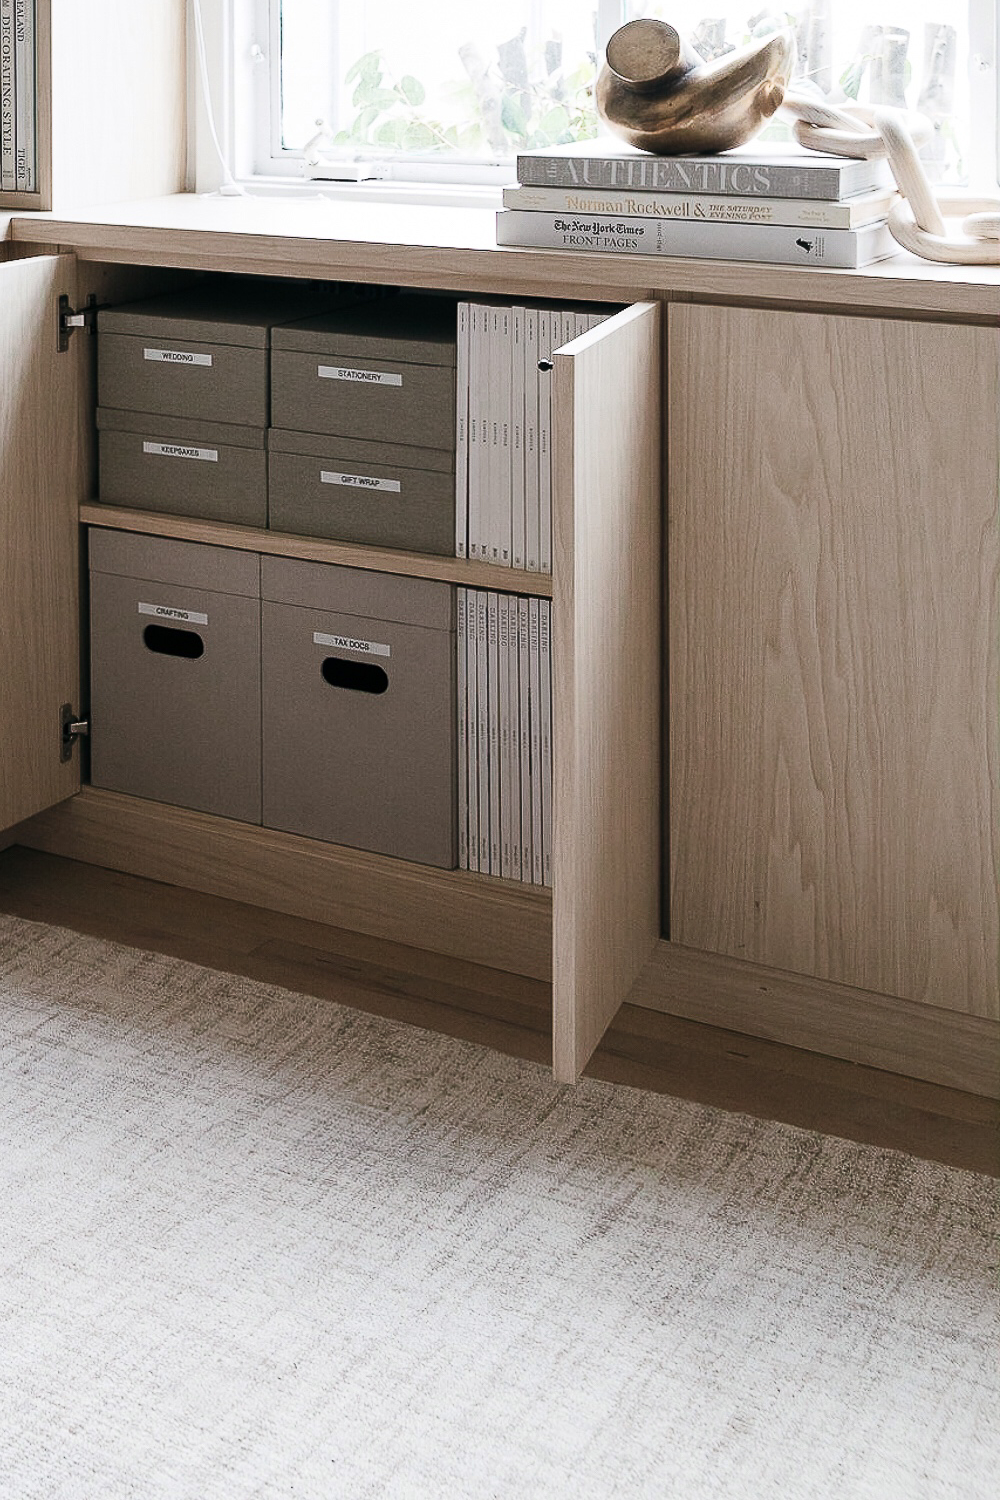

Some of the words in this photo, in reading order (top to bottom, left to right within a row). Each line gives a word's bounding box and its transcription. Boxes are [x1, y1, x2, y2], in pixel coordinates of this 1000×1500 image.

[17, 148, 25, 180] TIGER
[566, 160, 771, 192] AUTHENTICS
[565, 195, 624, 213] Norman
[623, 199, 690, 218] Rockwell
[693, 202, 707, 219] &
[708, 204, 725, 212] THE
[727, 204, 772, 214] SATURDAY
[707, 211, 747, 219] EVENING
[749, 212, 772, 220] POST
[554, 220, 573, 232] The
[572, 221, 592, 233] New
[592, 221, 616, 235] York
[616, 223, 645, 235] Times
[563, 235, 601, 247] FRONT
[603, 237, 639, 249] PAGES
[162, 352, 193, 362] WEDDING
[337, 370, 381, 382] STATIONERY
[358, 477, 380, 487] WRAP
[156, 607, 189, 619] CRAFTING
[334, 637, 348, 647] TAX
[349, 640, 369, 651] DOCS
